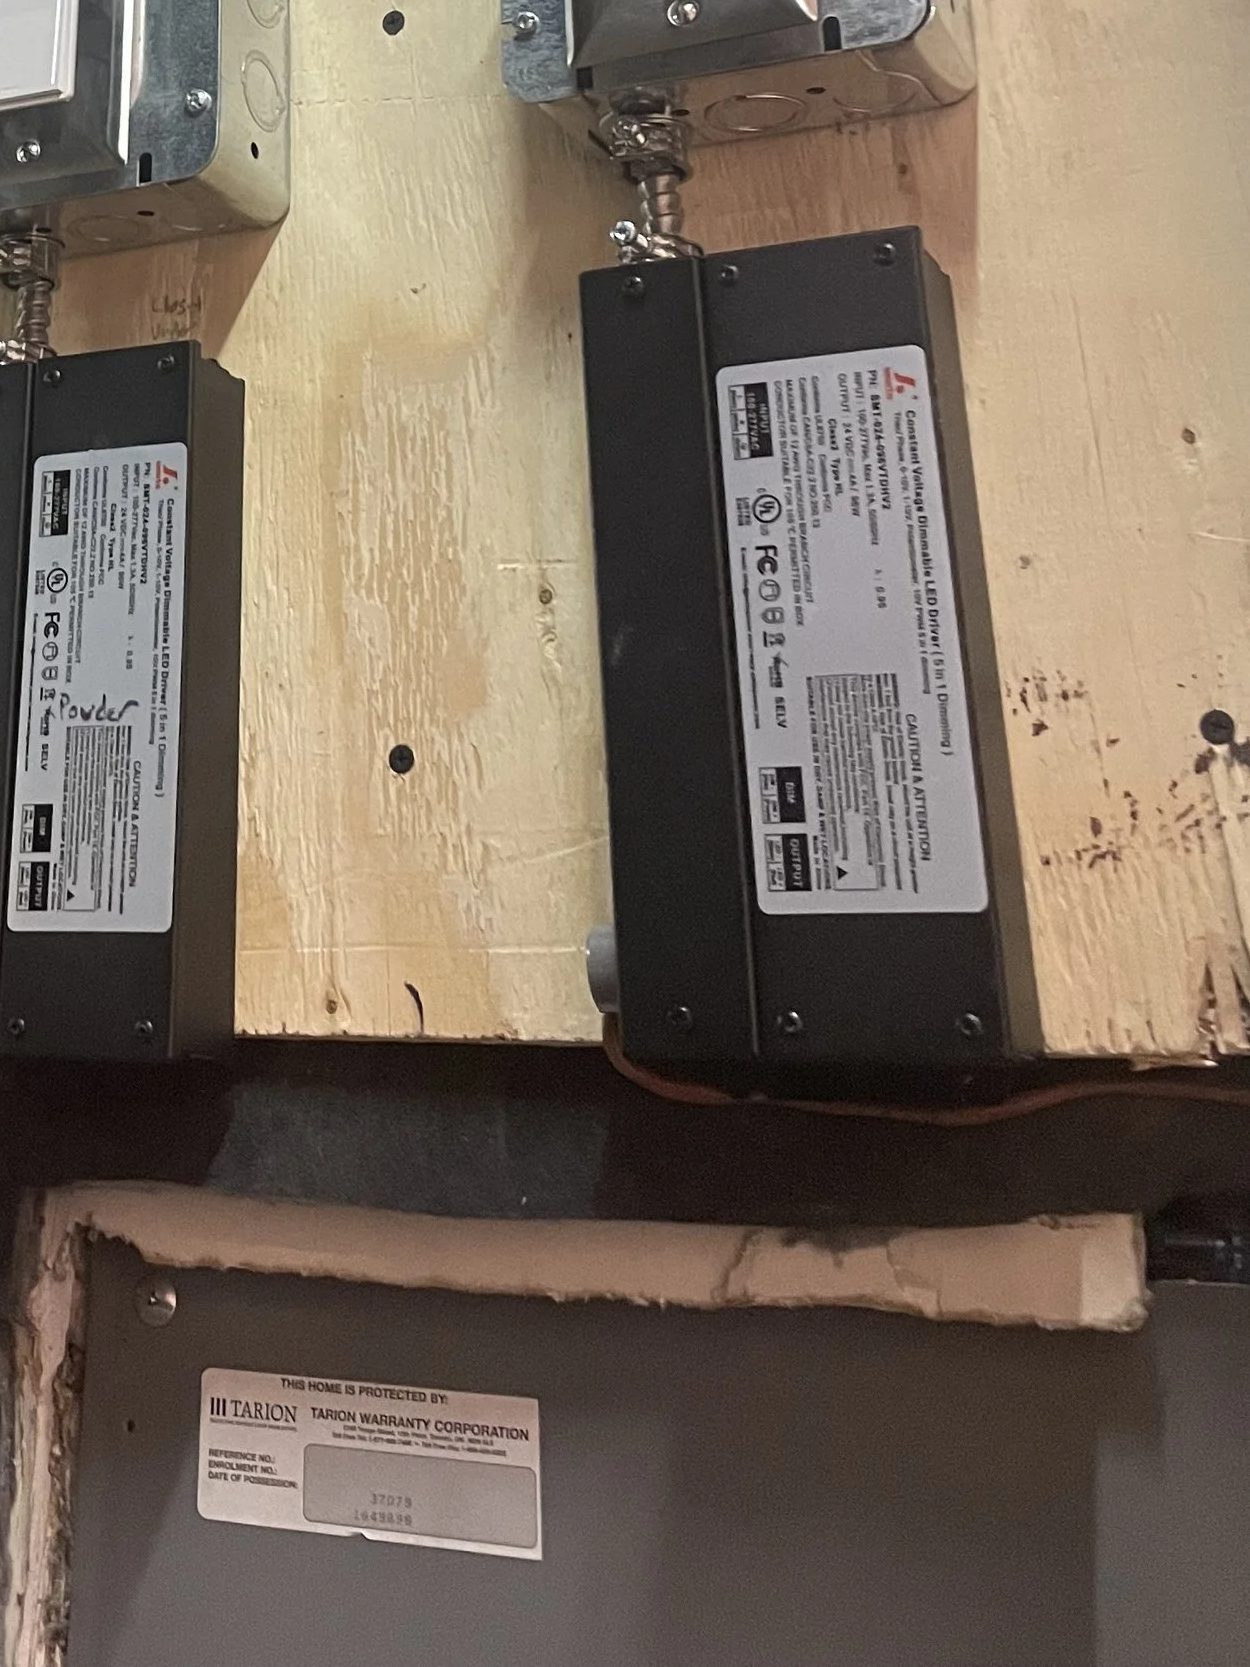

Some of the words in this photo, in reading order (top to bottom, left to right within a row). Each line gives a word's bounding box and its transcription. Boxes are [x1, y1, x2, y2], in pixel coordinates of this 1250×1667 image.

[905, 410, 921, 464] Constant
[909, 467, 927, 513] Voltage
[165, 498, 174, 545] Constant
[917, 516, 934, 578] Dimmable
[162, 548, 172, 587] Voltage
[924, 580, 937, 606] LED
[161, 590, 171, 643] Dimmable
[927, 609, 941, 649] Driver
[161, 646, 169, 668] LED
[59, 692, 139, 722] Powder
[160, 671, 168, 705] Driver
[934, 693, 952, 748] Dimming
[131, 760, 141, 810] CAUTION
[155, 743, 165, 790] Dimming
[904, 714, 920, 772] CAUTION
[912, 786, 930, 861] ATTENTION
[128, 823, 138, 887] ATTENTION
[281, 1377, 304, 1390] THIS
[308, 1380, 341, 1394] HOME
[345, 1384, 354, 1395] IS
[358, 1385, 426, 1402] PROTECTED
[430, 1393, 447, 1404] BY:
[230, 1398, 297, 1423] TARION
[310, 1406, 355, 1422] TARION
[359, 1411, 430, 1430] WARRANTY
[434, 1419, 529, 1441] CORPORATION
[208, 1448, 257, 1461] REFERENCE
[208, 1459, 258, 1473] ENROLMENT
[207, 1470, 228, 1481] DATE
[230, 1473, 242, 1482] OF
